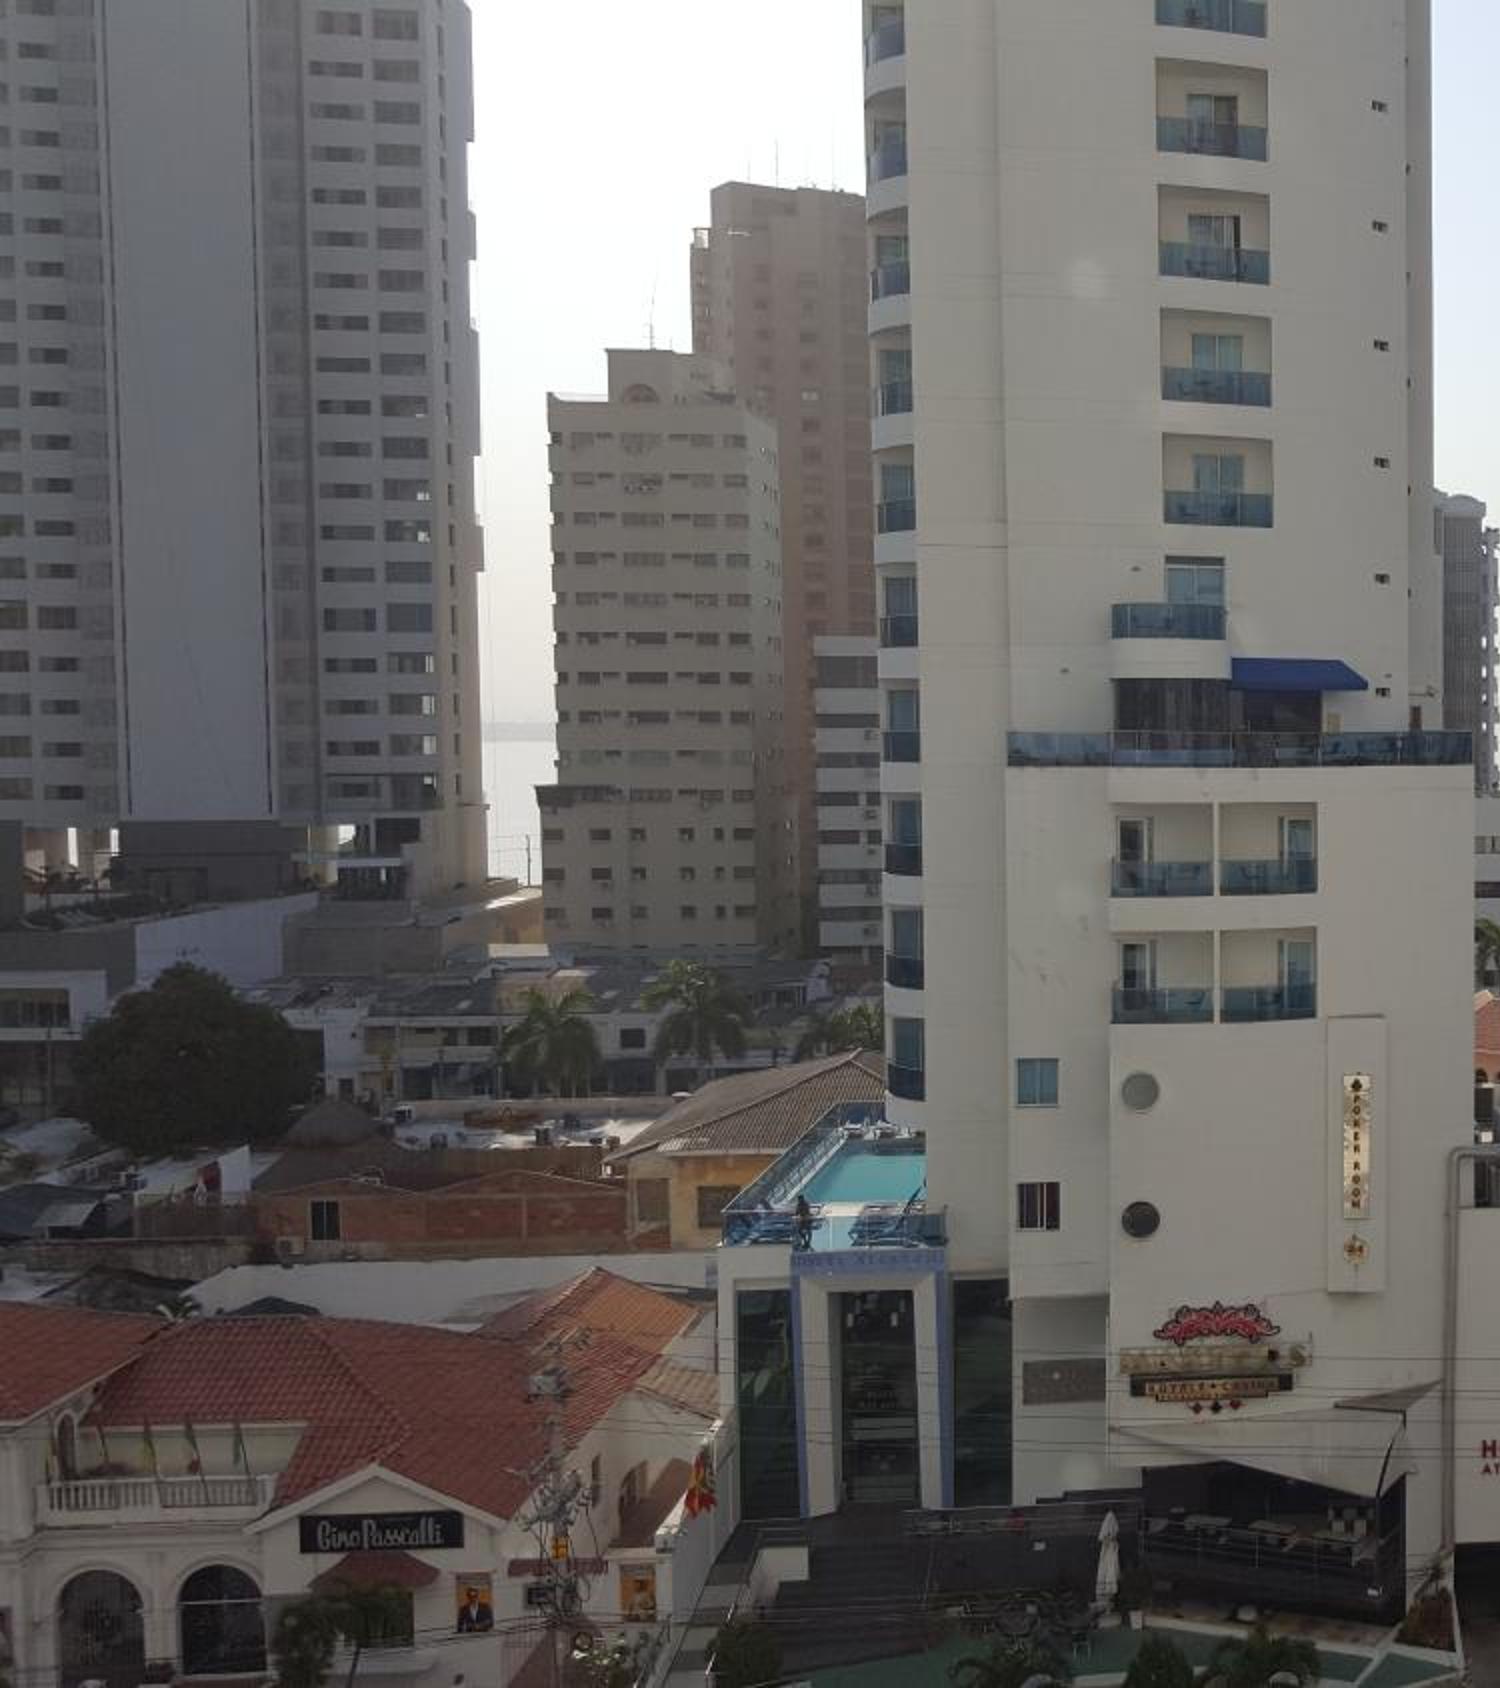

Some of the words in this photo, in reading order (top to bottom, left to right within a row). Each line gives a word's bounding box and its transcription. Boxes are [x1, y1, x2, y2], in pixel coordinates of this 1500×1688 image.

[1352, 1094, 1361, 1153] POKER
[1351, 1161, 1361, 1209] ROOM
[316, 1520, 361, 1552] Gino
